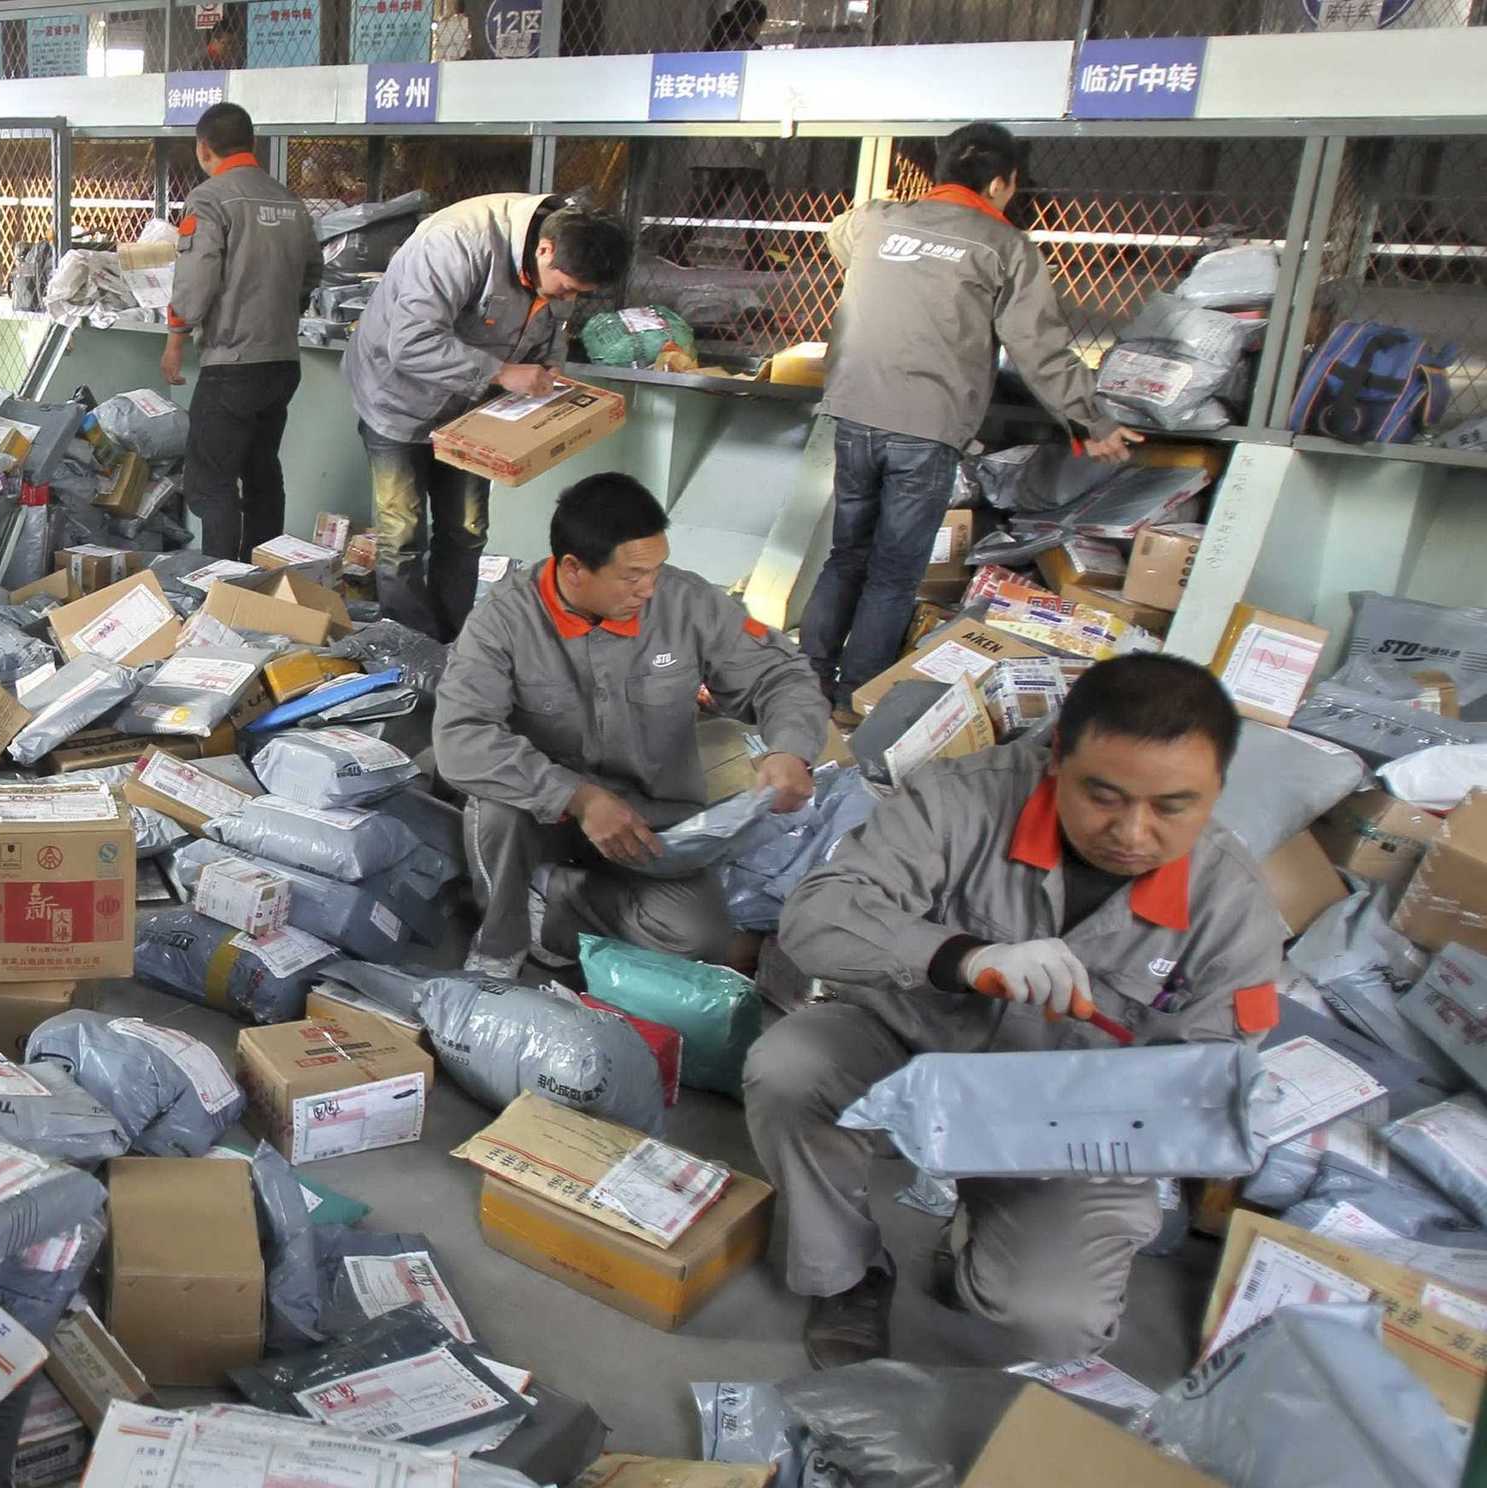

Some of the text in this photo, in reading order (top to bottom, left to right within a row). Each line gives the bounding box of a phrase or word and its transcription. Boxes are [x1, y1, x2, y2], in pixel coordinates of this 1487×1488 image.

[492, 9, 543, 34] 12区
[653, 72, 740, 99] 淮安中转
[1081, 62, 1198, 93] 临沂中转
[167, 87, 223, 108] 徐州中转
[375, 77, 431, 109] 徐州
[881, 234, 922, 256] STO
[1378, 640, 1421, 656] STO
